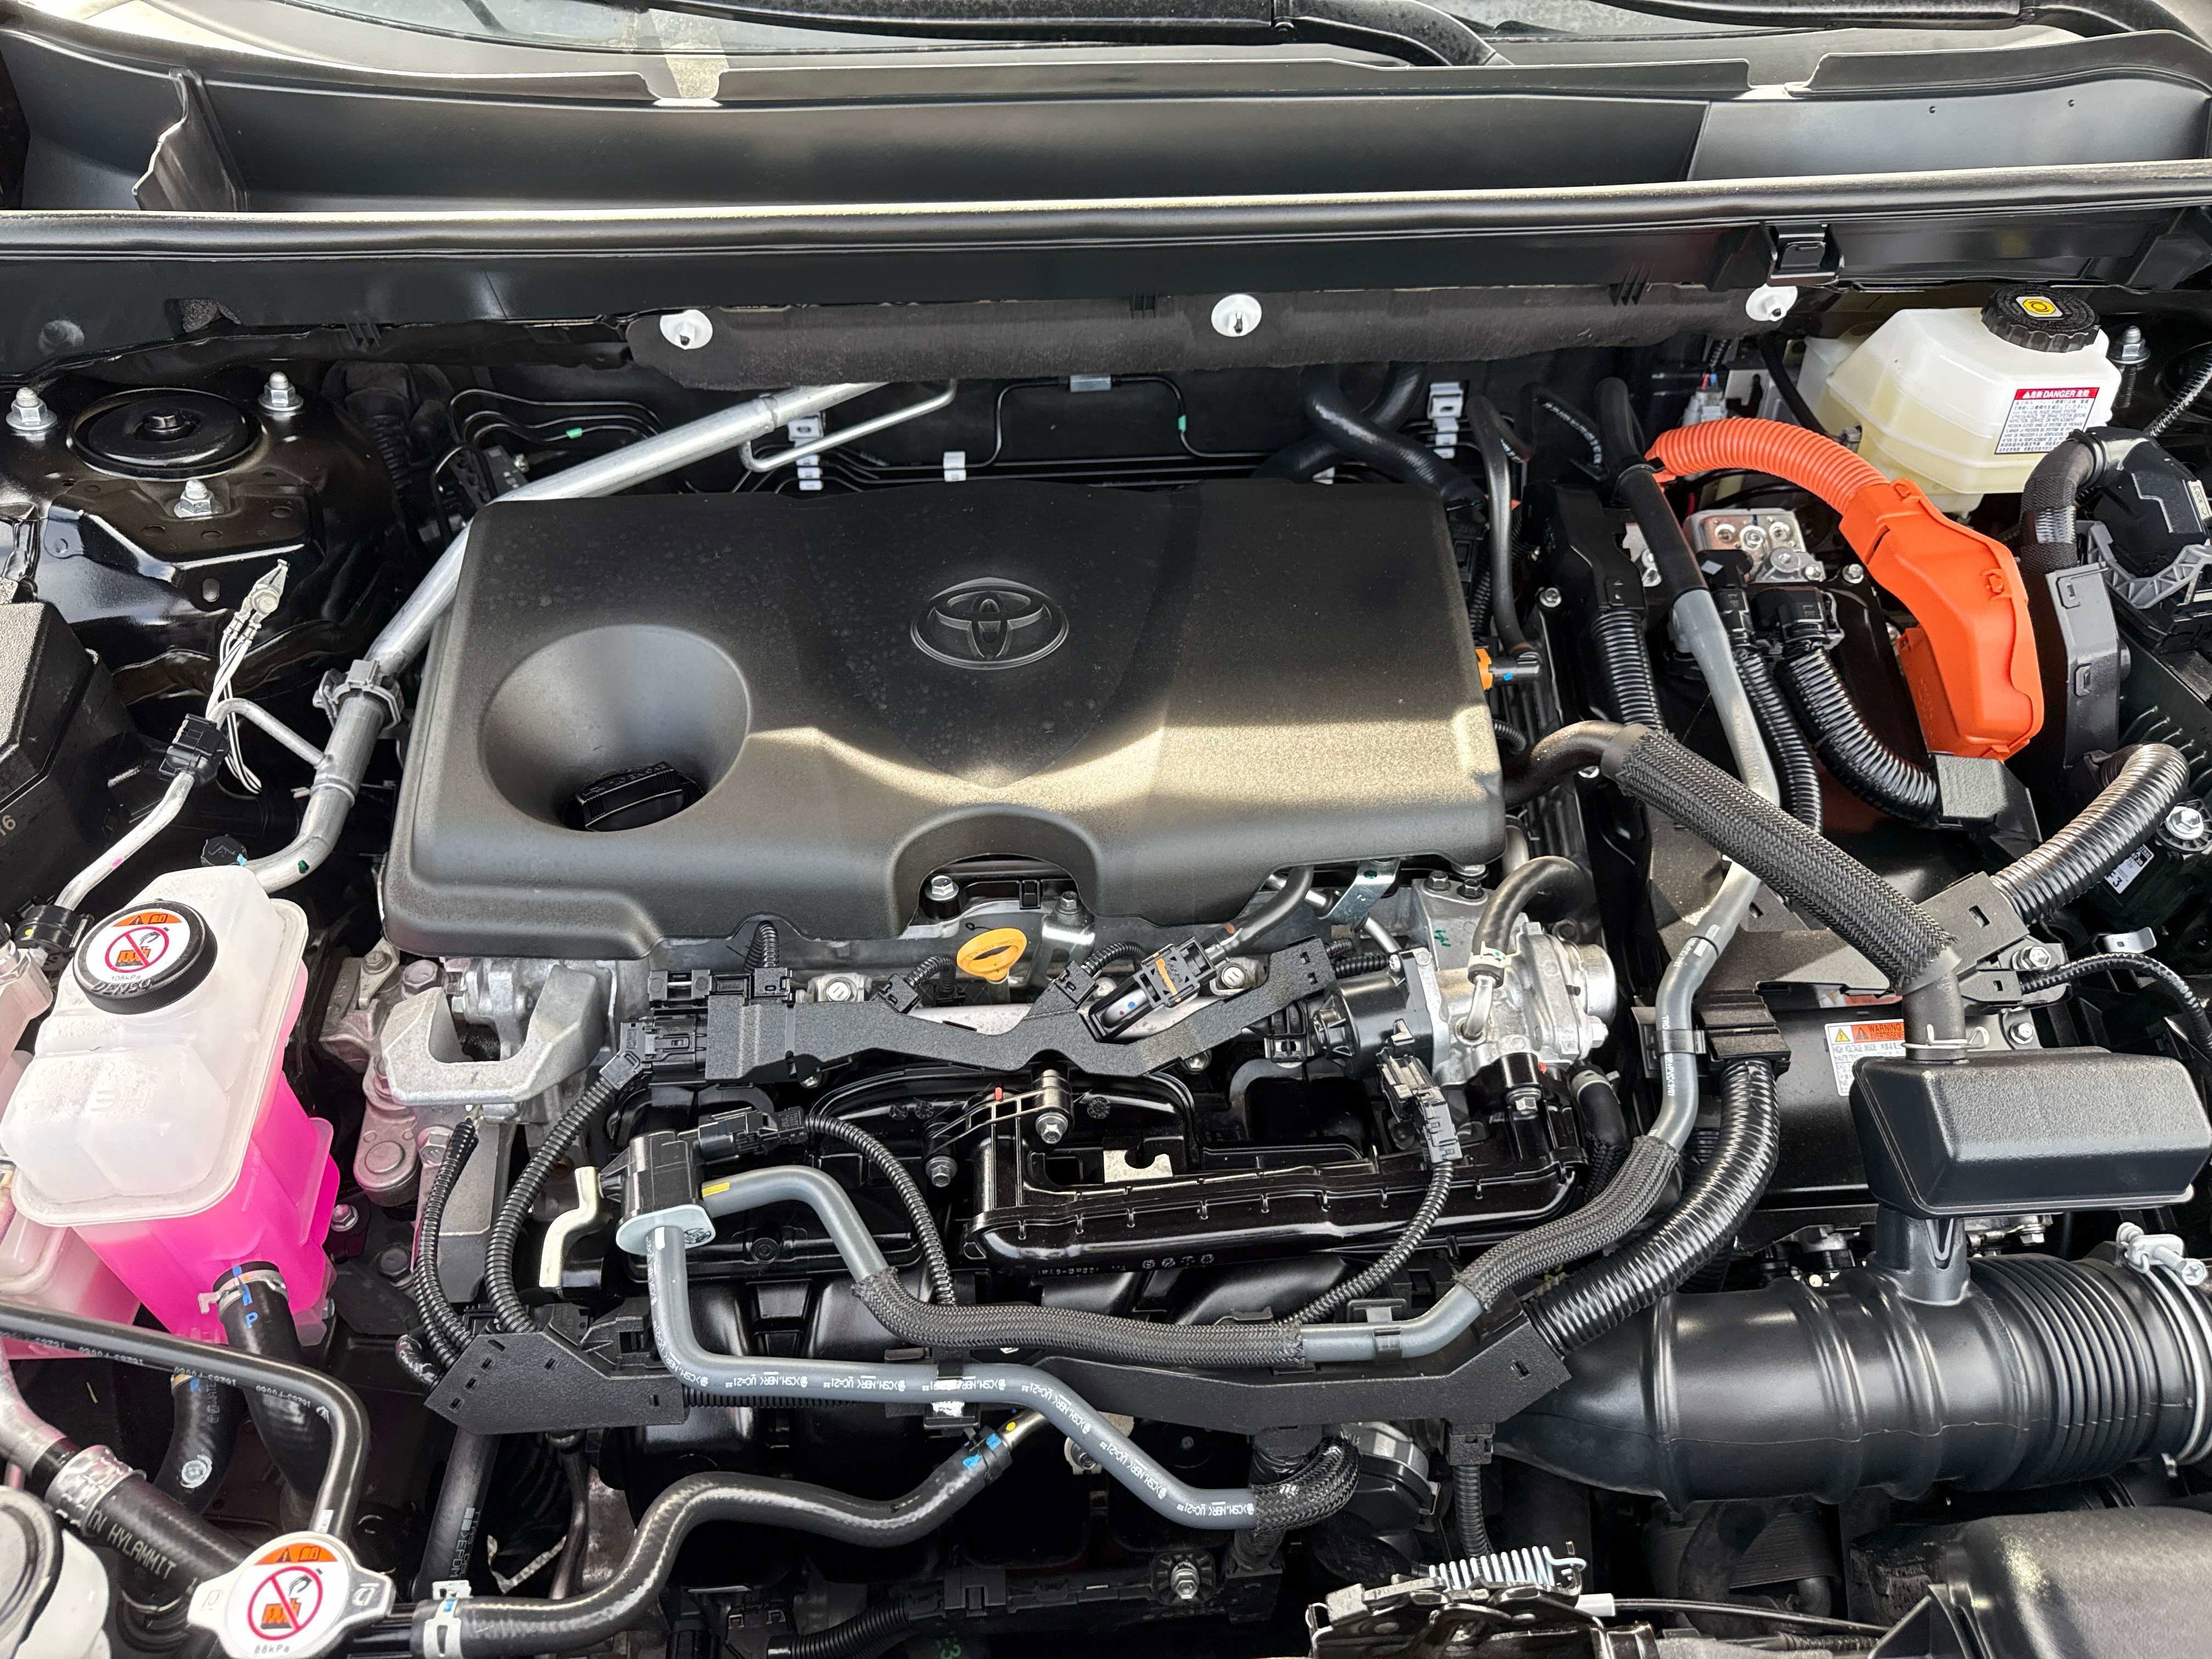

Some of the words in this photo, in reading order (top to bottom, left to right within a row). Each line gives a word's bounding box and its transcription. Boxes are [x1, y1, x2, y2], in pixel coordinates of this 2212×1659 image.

[2043, 390, 2075, 398] DANGER
[91, 978, 153, 996] DENSO
[1867, 1023, 1901, 1032] WARNING
[245, 1312, 258, 1328] P
[107, 1523, 177, 1579] HYLAMMIT
[254, 1644, 290, 1654] 88kPa
